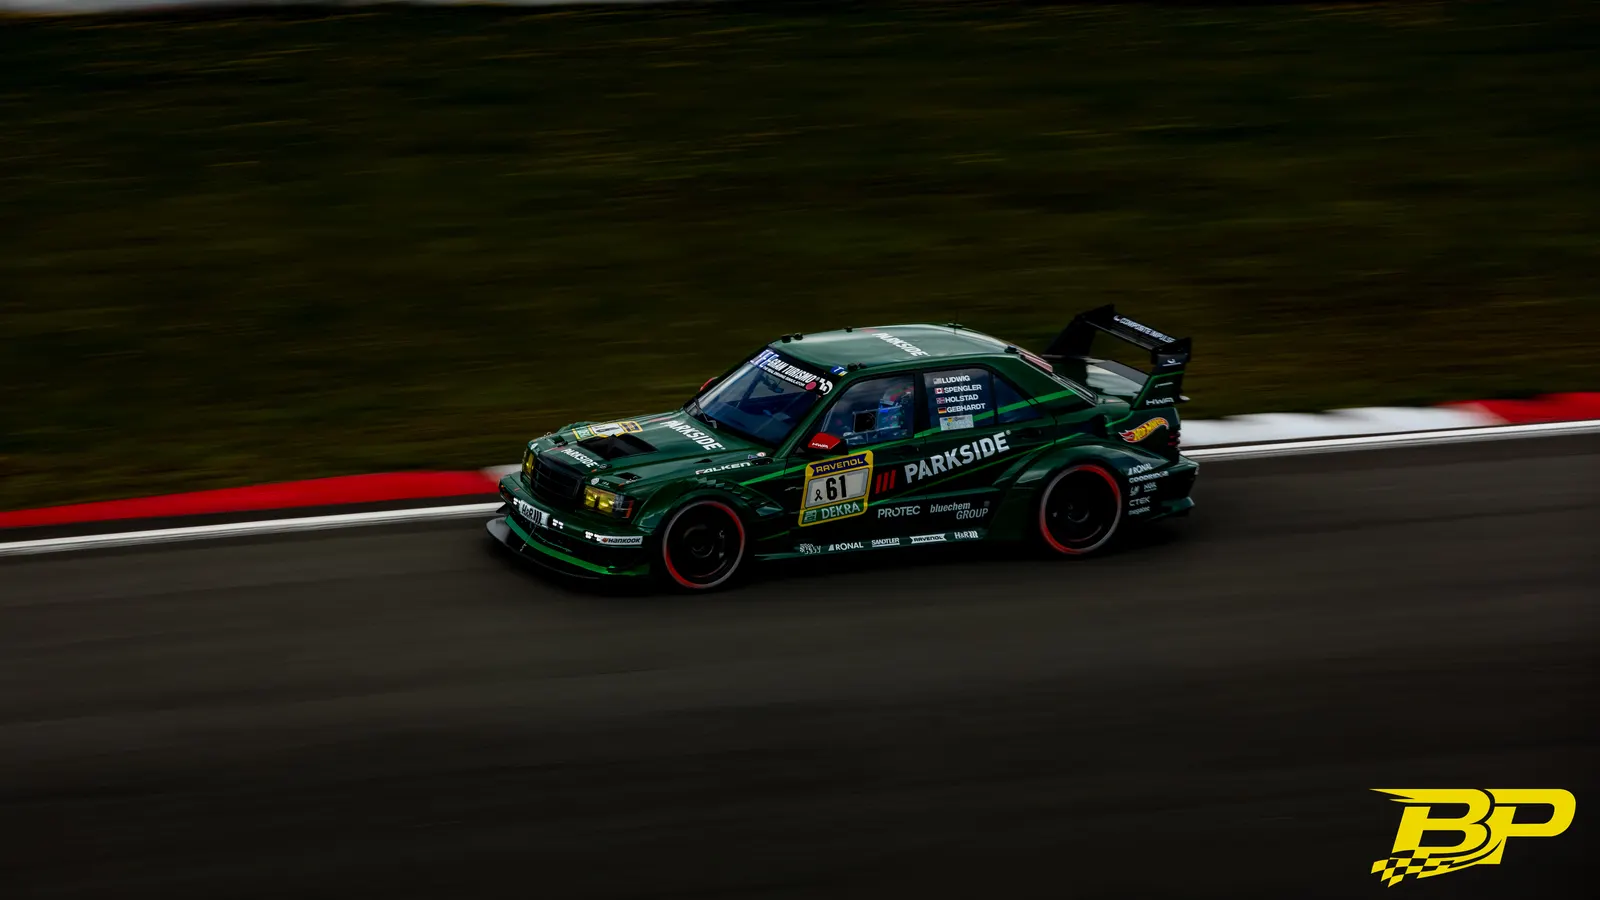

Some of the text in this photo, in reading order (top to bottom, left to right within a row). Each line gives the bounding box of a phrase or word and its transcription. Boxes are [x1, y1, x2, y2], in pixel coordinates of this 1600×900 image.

[766, 358, 789, 371] GRAN
[782, 365, 818, 383] TURISMO
[942, 375, 970, 383] LUDWIG
[944, 384, 982, 393] SPENGLER
[945, 394, 979, 403] HOLSTAD
[947, 403, 986, 413] GEBHARDT
[660, 420, 723, 450] PARKSIDE
[561, 448, 597, 468] PARKSIDE
[904, 431, 1010, 484] PARKSIDE
[695, 461, 752, 475] FALKEN
[815, 457, 863, 473] RAVENOL
[1133, 463, 1153, 474] RONAL
[825, 475, 847, 501] 61
[821, 501, 860, 519] DEKRA
[877, 505, 921, 519] PROTEC
[930, 502, 971, 514] bluechem
[956, 507, 988, 520] GROUP
[913, 534, 945, 543] RAVENOL
[835, 542, 864, 551] RONAL
